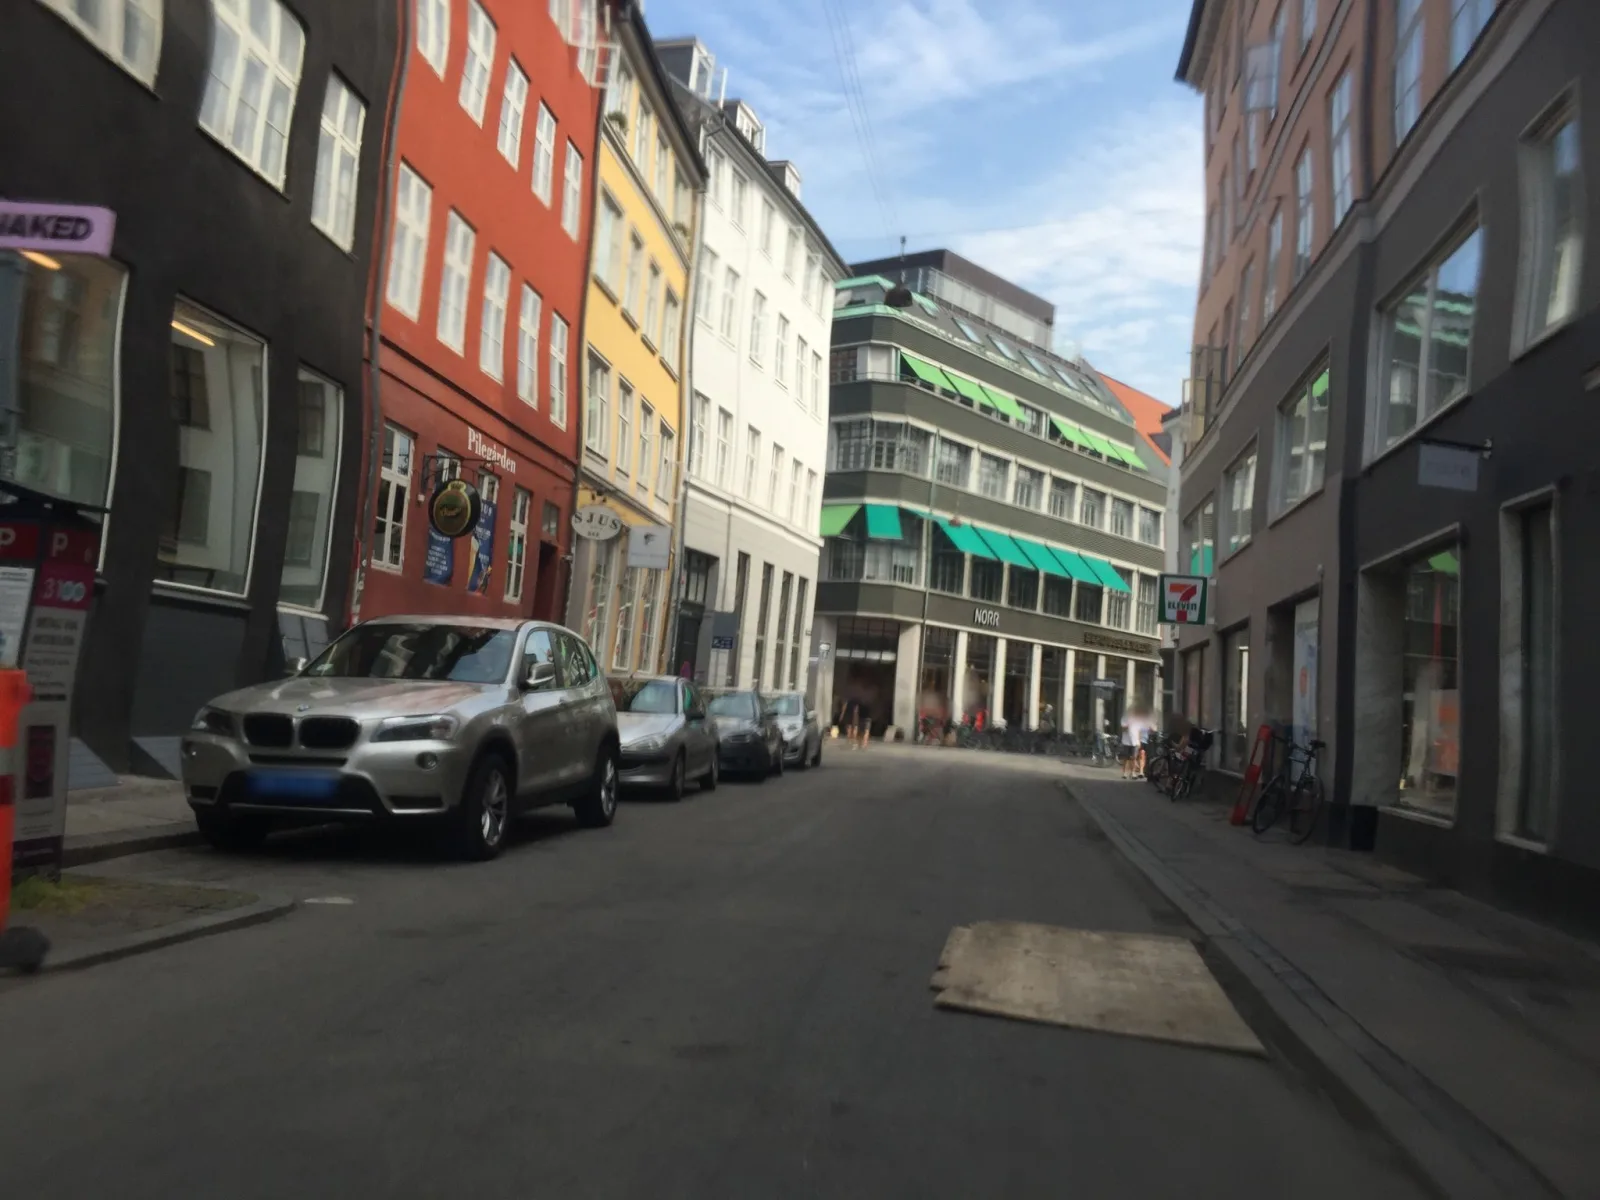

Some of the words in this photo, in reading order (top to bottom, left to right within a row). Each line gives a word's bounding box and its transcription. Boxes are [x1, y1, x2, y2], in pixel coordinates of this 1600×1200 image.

[467, 426, 517, 476] Pilegården
[574, 511, 621, 530] SJUS
[51, 532, 69, 558] P
[974, 607, 1000, 627] NORR
